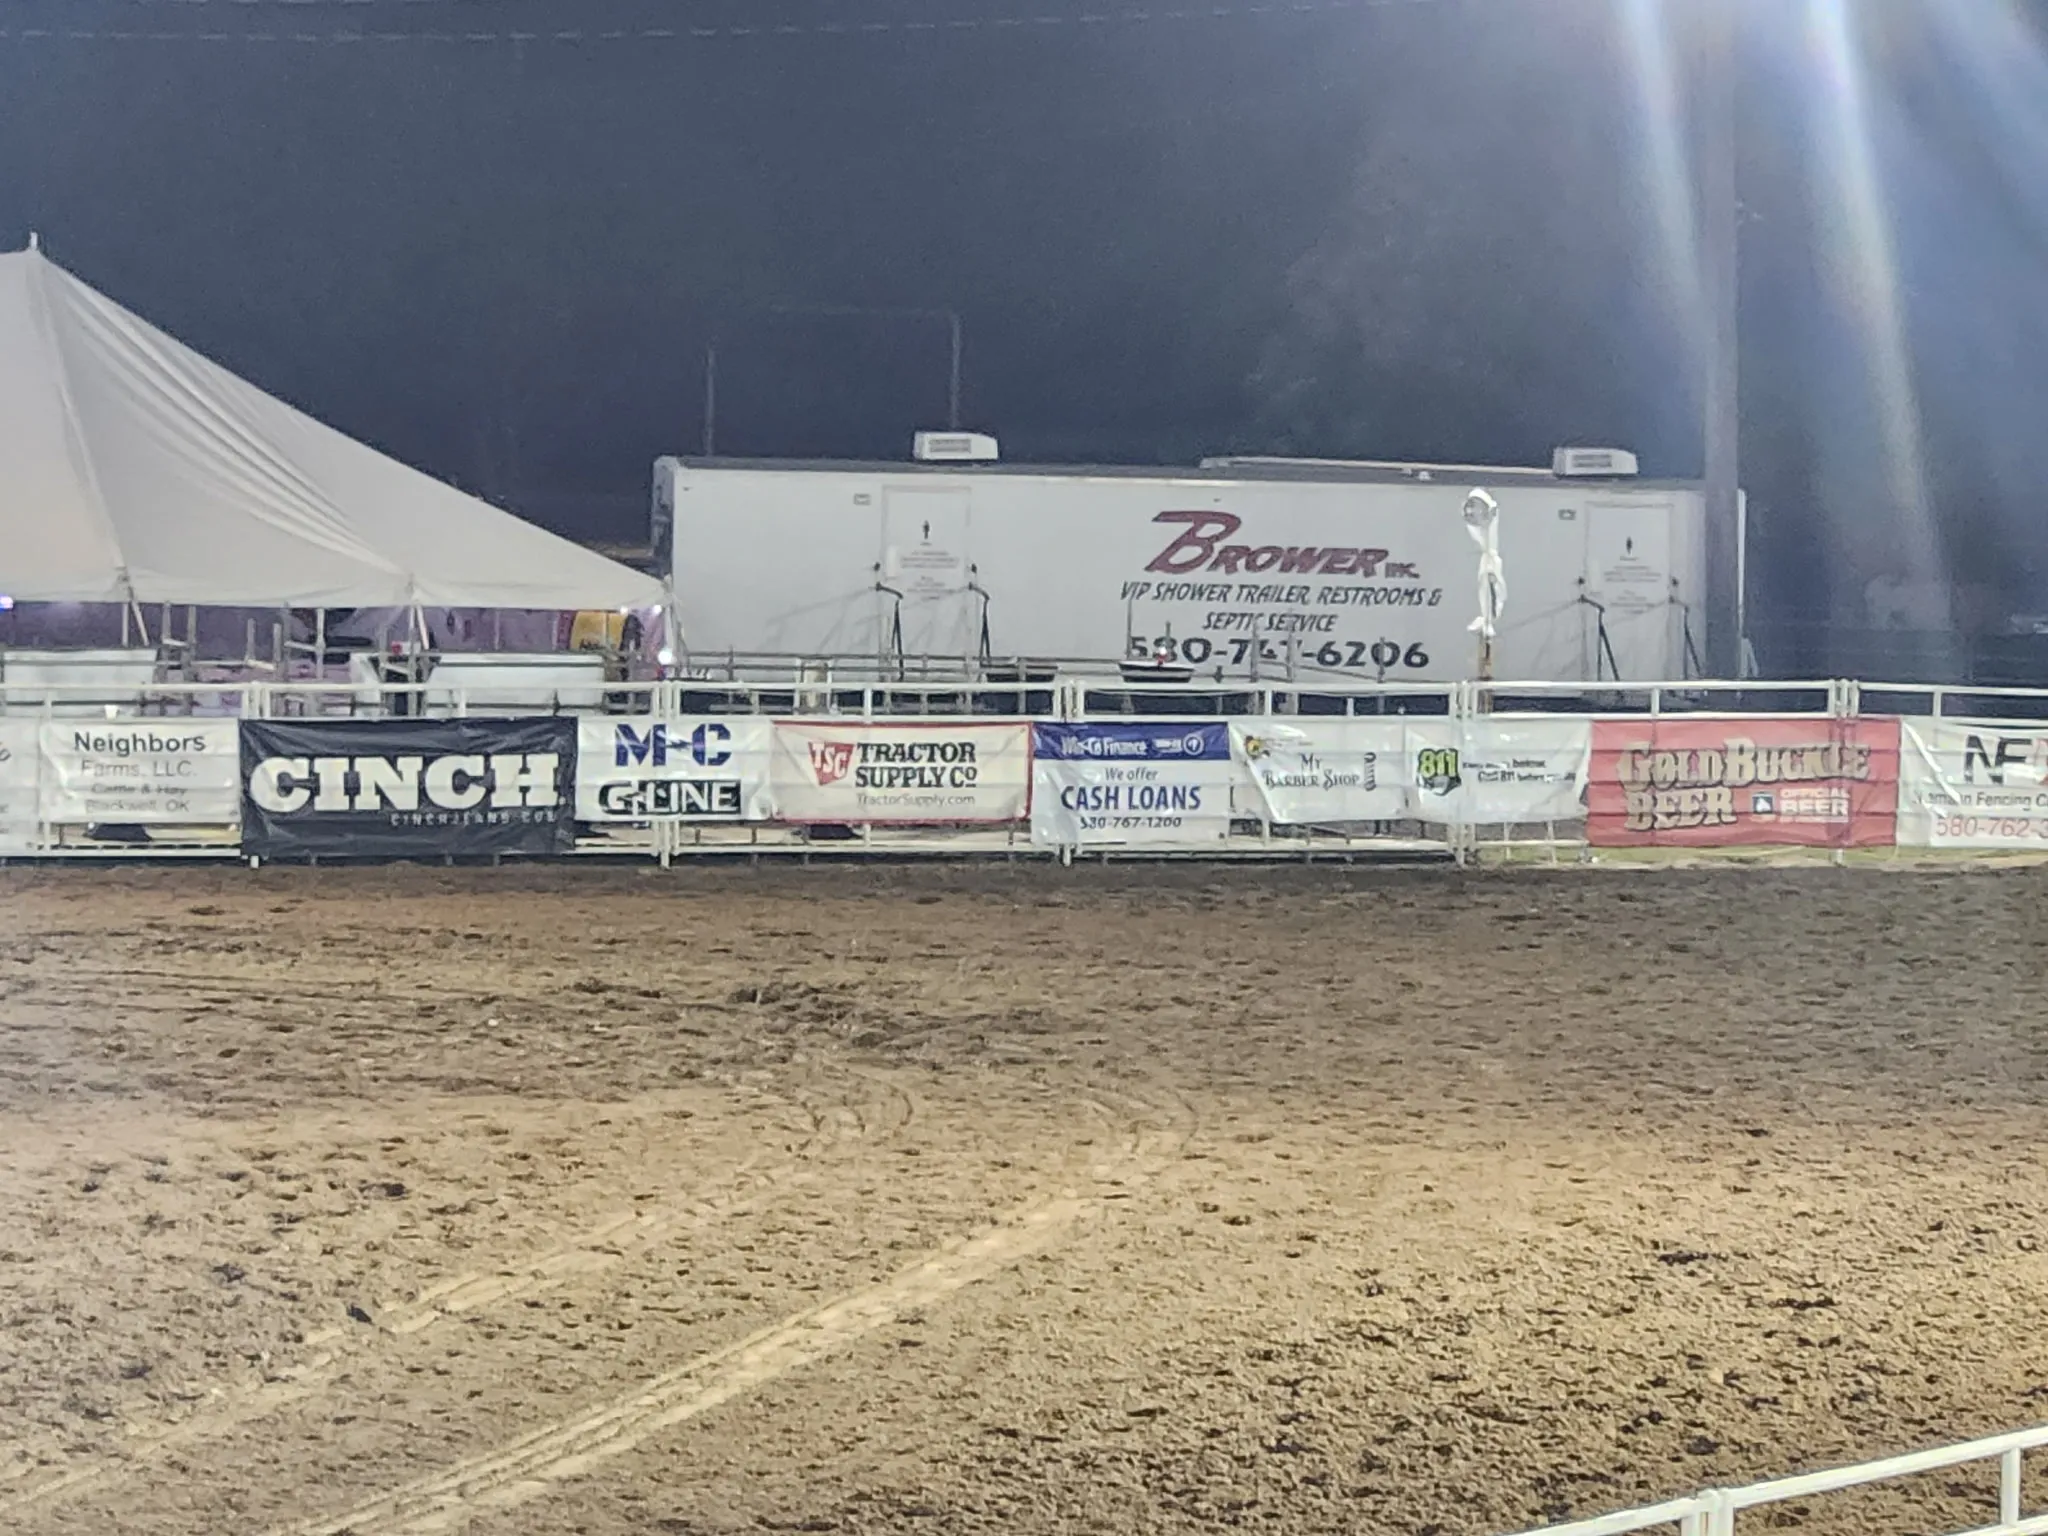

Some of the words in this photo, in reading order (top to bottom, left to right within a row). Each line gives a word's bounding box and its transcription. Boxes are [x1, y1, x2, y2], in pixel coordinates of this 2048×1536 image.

[1120, 581, 1151, 600] VIP
[1152, 582, 1232, 603] SHOWER
[1235, 584, 1311, 605] TRAILER
[1316, 586, 1426, 606] RESTROOMS
[1427, 588, 1443, 606] &
[1202, 611, 1263, 632] SEPTIC
[1264, 613, 1338, 632] SERVICE
[74, 732, 206, 757] Neighbors
[812, 742, 848, 777] TSC
[857, 742, 976, 763] TRACTOR
[1418, 748, 1458, 778] 811
[249, 753, 560, 812] CINCH
[855, 766, 946, 788] SUPPLY
[1105, 766, 1124, 781] We
[1126, 766, 1158, 781] offer
[166, 799, 191, 813] OK
[857, 793, 975, 808] TractorSupply.com
[1060, 785, 1119, 810] CASH
[1128, 785, 1202, 810] LOANS
[1780, 799, 1849, 816] BEER
[1975, 791, 2031, 811] Fencing
[1624, 787, 1738, 832] BEER
